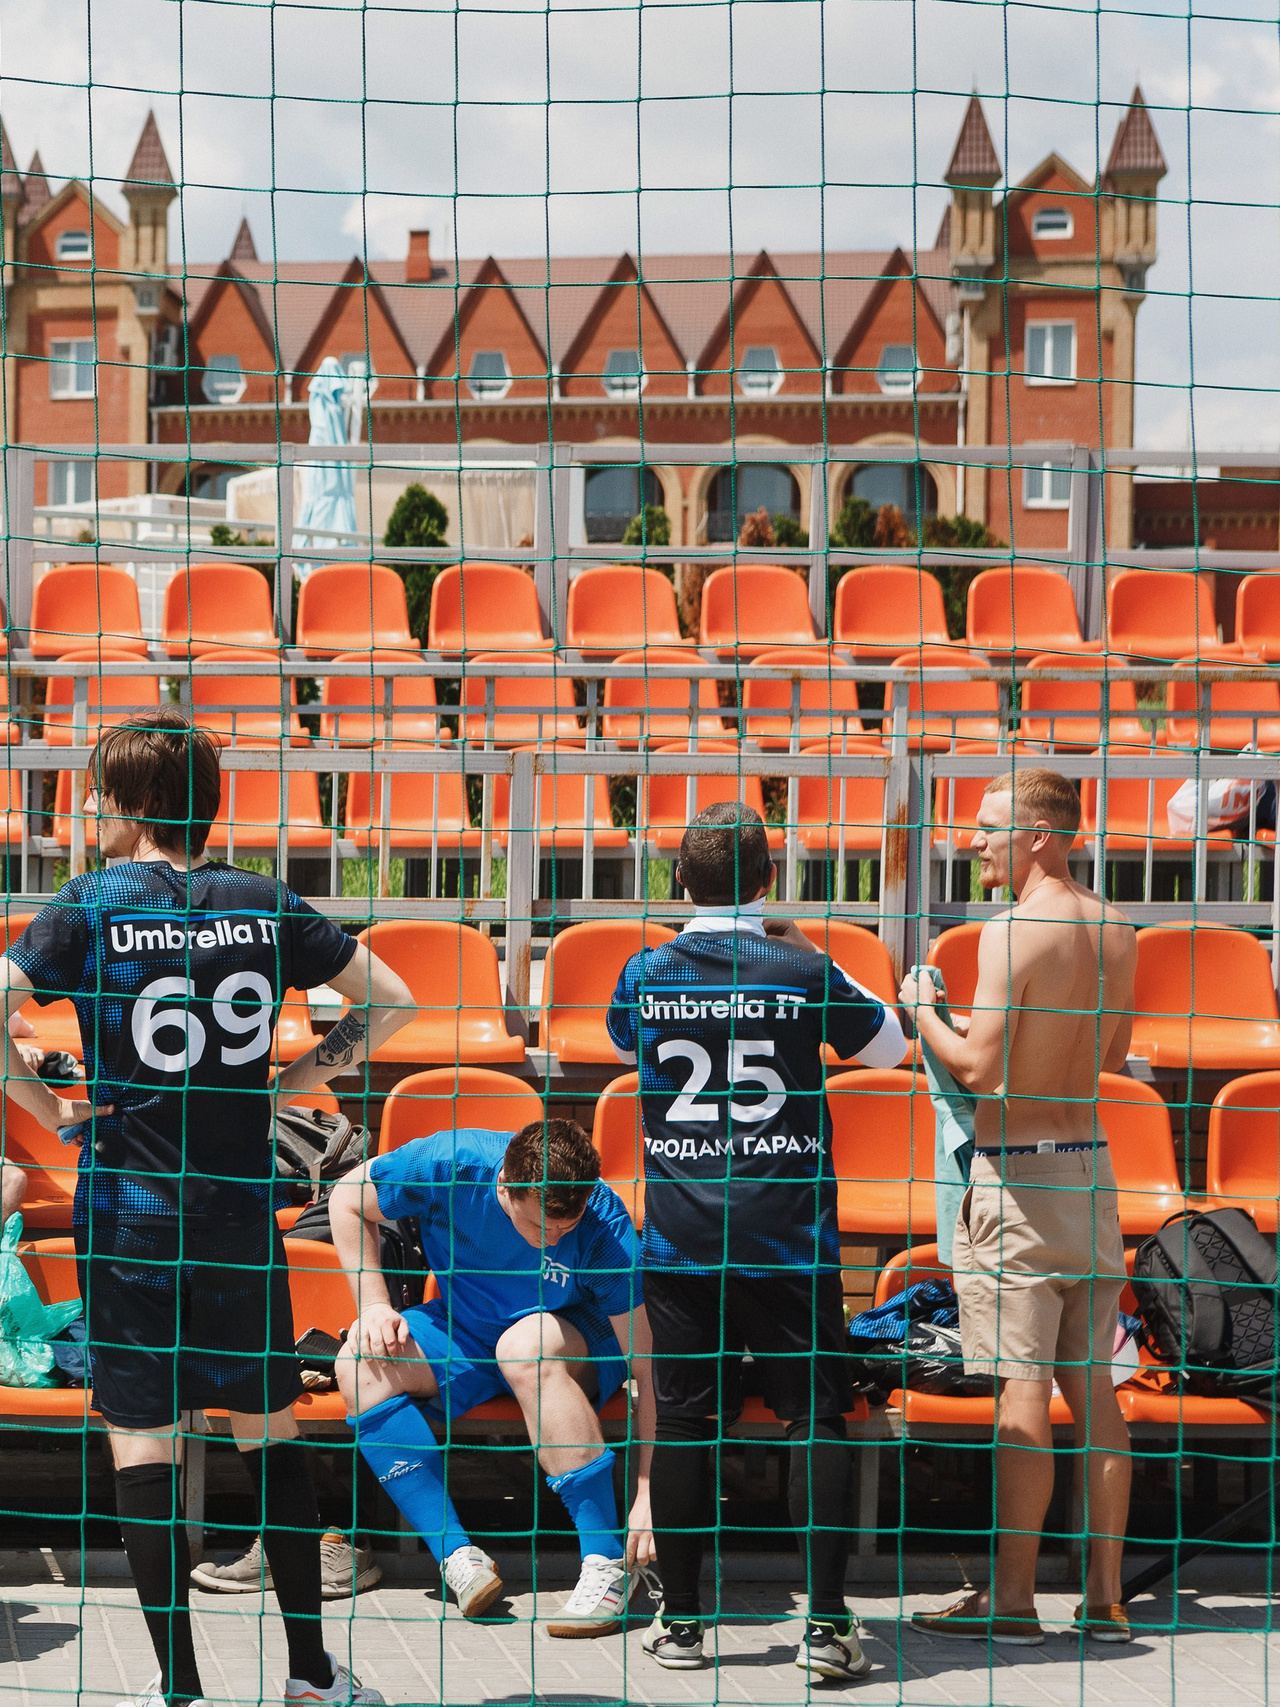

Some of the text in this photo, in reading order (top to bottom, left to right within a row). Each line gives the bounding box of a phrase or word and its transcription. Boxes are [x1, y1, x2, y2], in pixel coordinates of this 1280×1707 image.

[110, 919, 254, 953] Umbrella
[131, 971, 273, 1072] 69
[639, 993, 806, 1020] Umbrella IT
[657, 1039, 787, 1123] 25
[743, 1134, 826, 1156] ГАРАЖ
